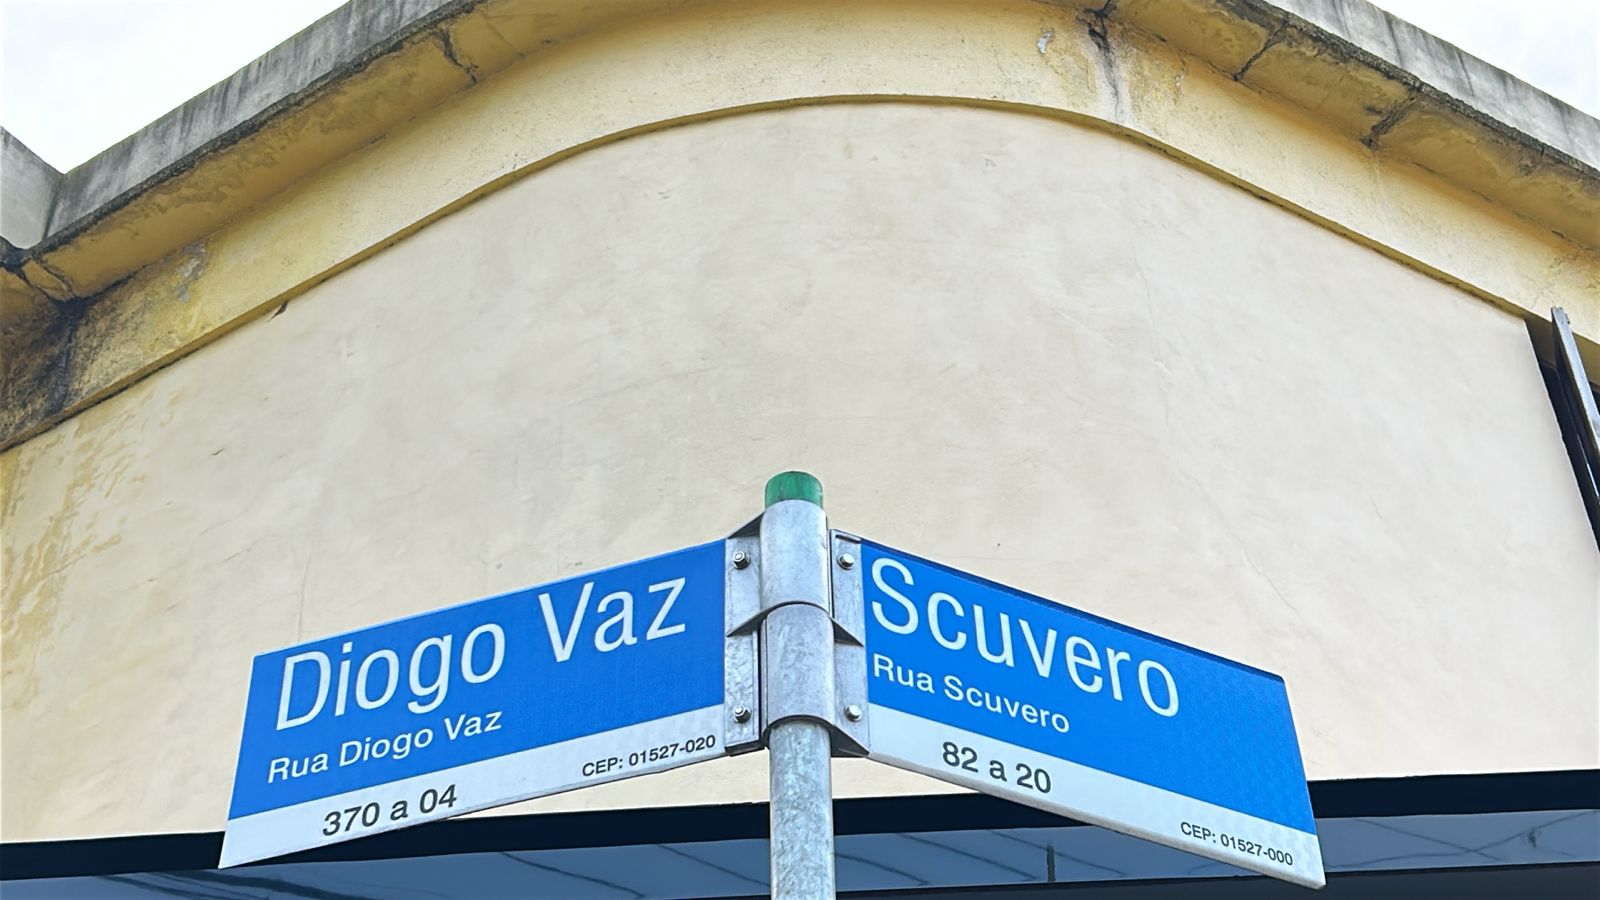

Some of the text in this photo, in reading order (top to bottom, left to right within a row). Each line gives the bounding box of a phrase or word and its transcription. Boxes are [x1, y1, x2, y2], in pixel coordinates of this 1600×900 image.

[276, 577, 686, 731] Diogo Vaz
[871, 557, 1179, 717] Scuvero
[873, 653, 1071, 734] Rua Scuvero
[267, 711, 503, 784] Rua Diogo Vaz
[582, 734, 717, 777] CEP: 01527-020
[942, 741, 1052, 794] 82 a 20
[322, 784, 458, 837] 370 a 04
[1180, 821, 1293, 867] CEP: 01527-000
